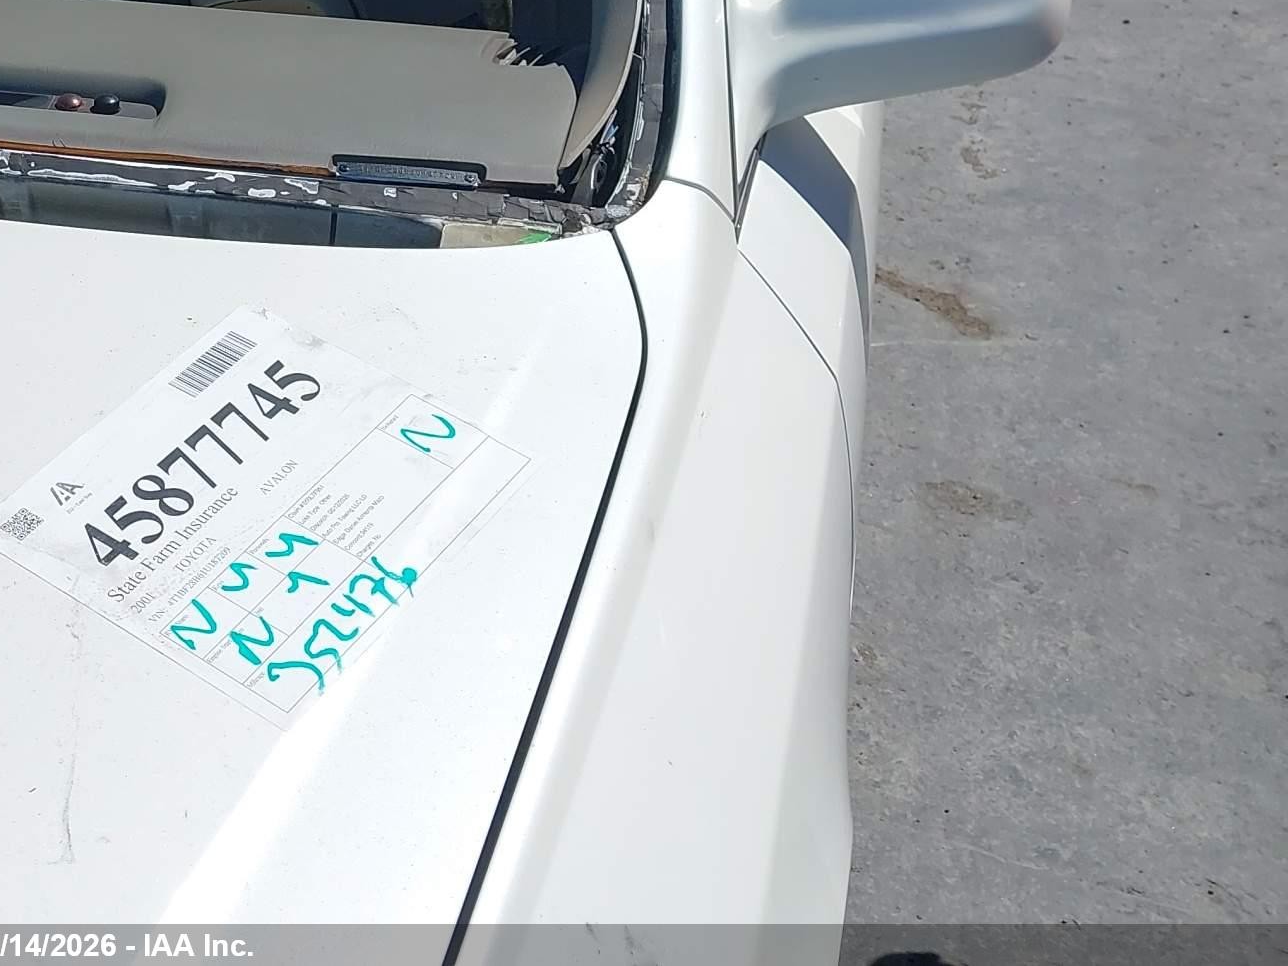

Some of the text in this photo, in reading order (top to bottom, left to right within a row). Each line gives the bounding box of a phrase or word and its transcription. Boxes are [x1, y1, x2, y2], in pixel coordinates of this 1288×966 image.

[85, 359, 321, 567] 45877745
[400, 414, 456, 452] N
[107, 486, 239, 603] State Farm Insurance
[130, 459, 299, 614] 2001 TOYOTA AVALON
[170, 599, 217, 650] N
